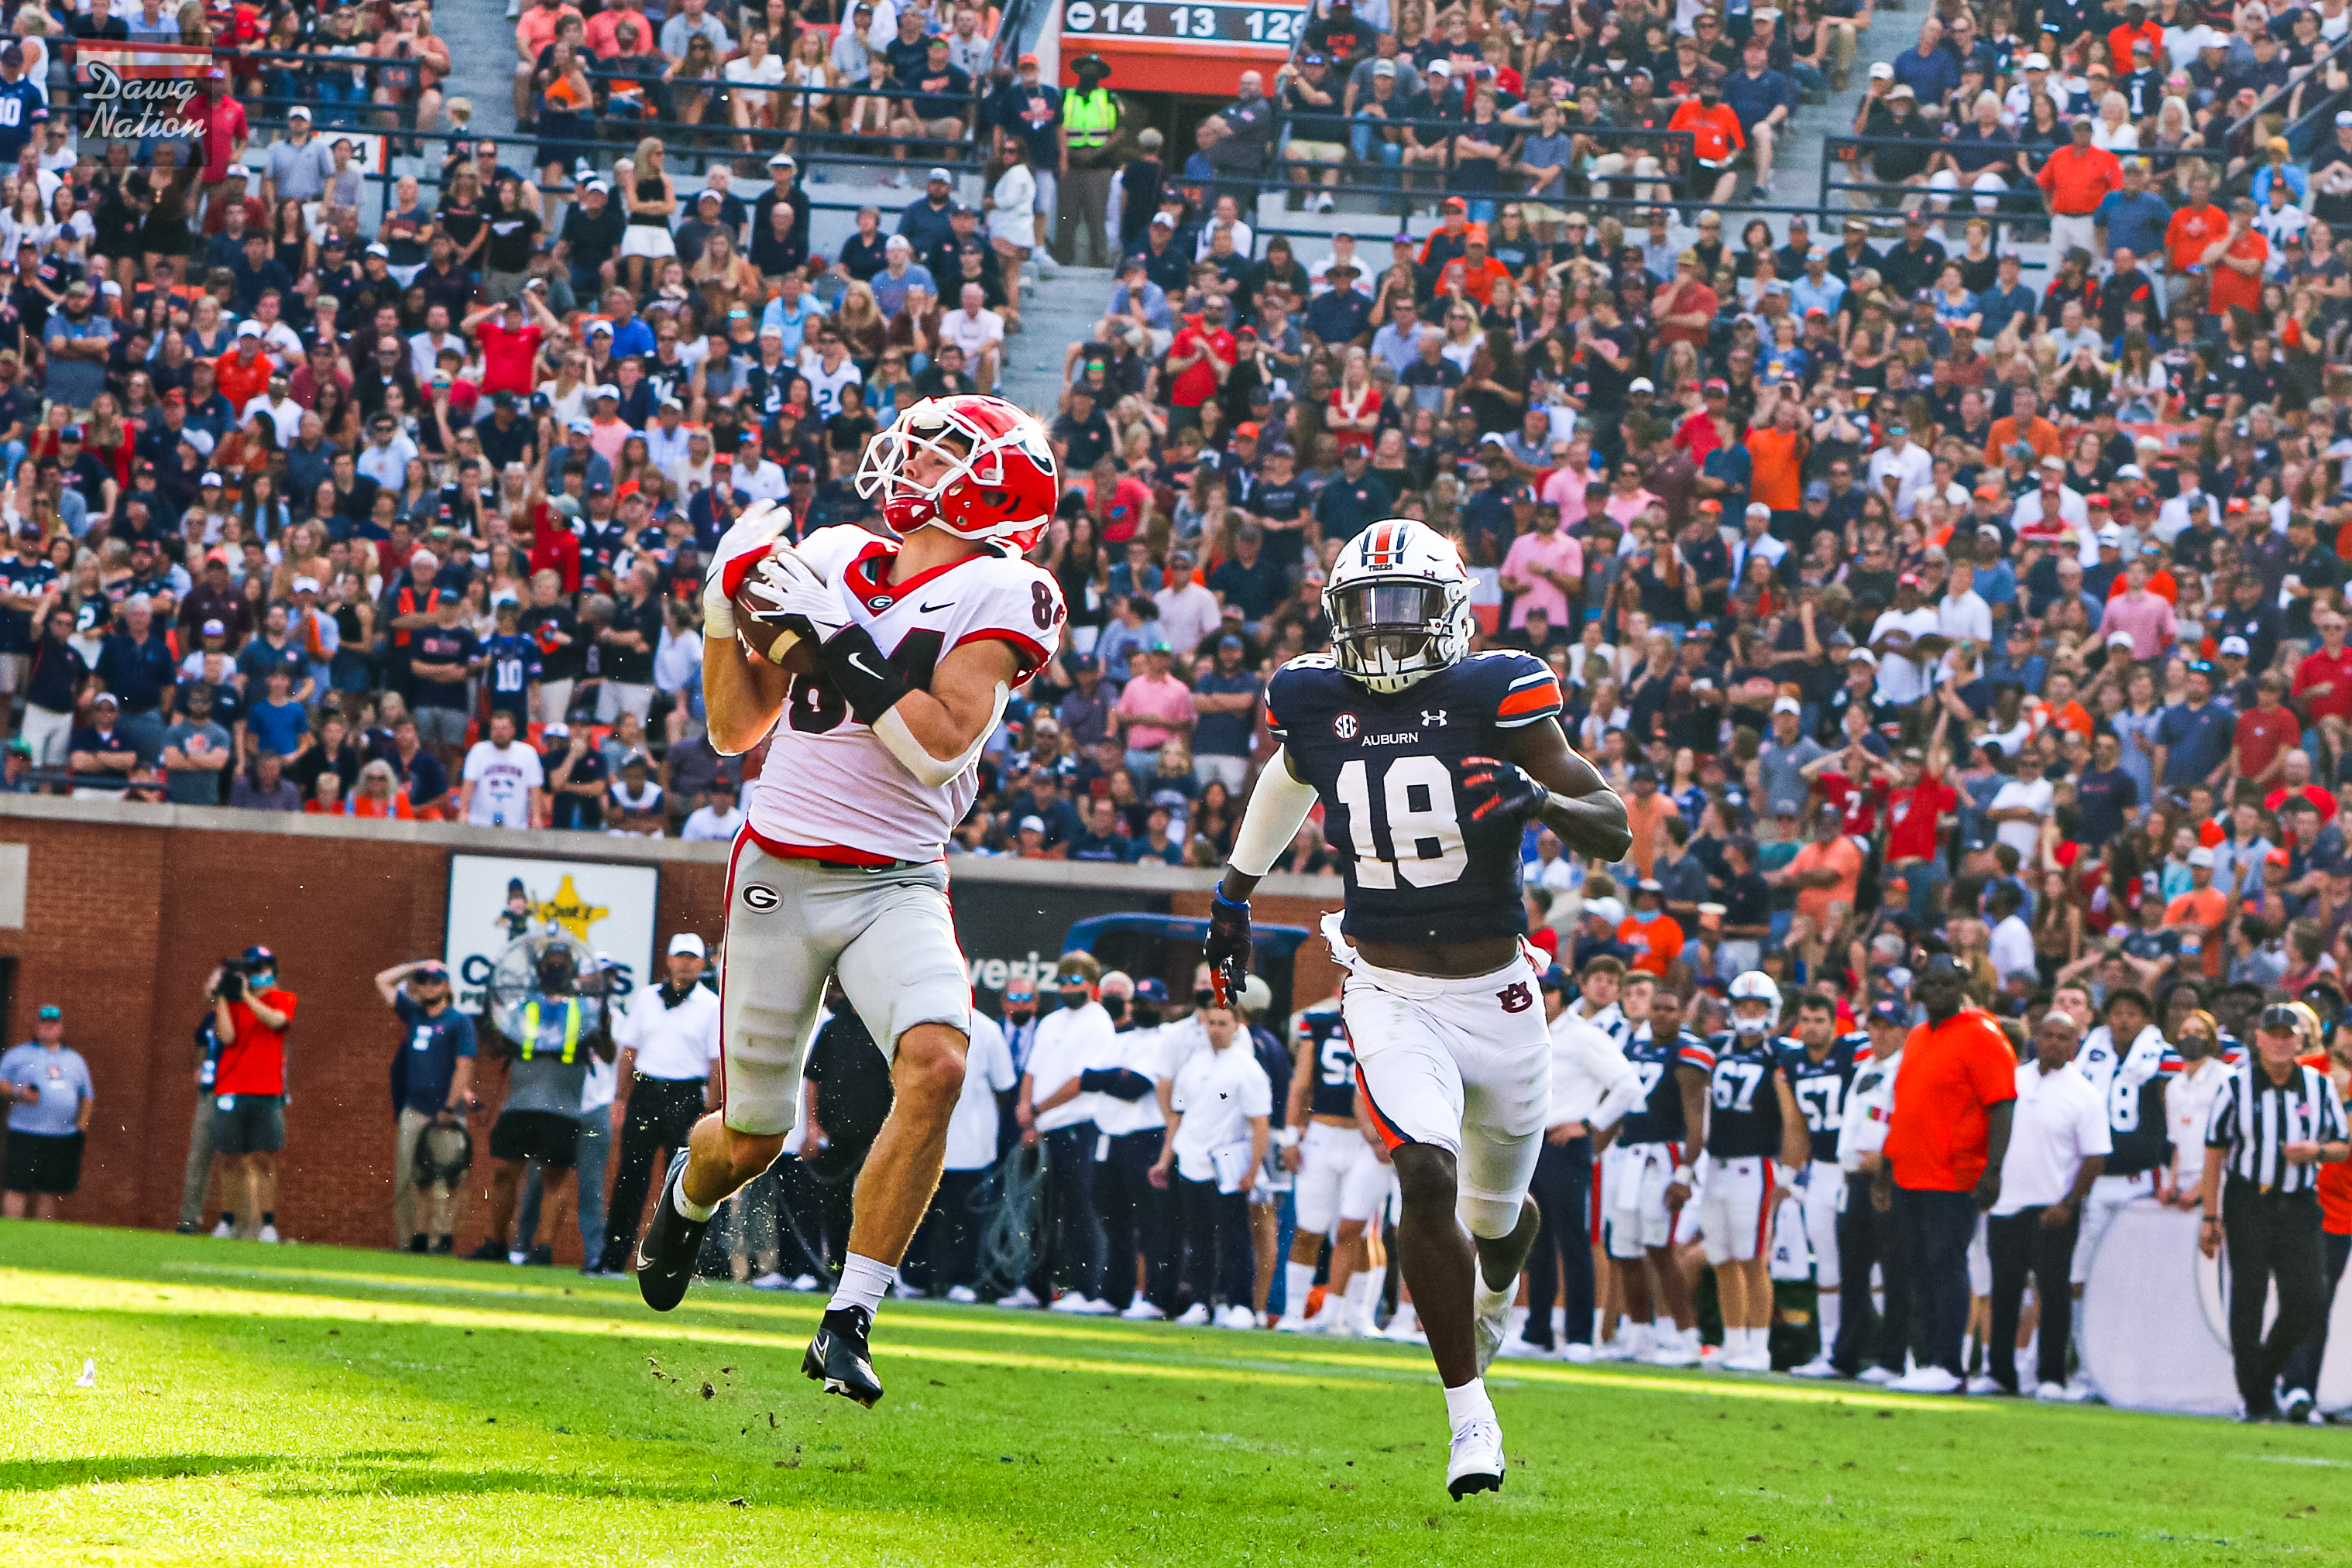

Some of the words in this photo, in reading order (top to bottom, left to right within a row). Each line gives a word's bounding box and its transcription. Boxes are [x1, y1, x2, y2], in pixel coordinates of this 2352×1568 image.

[1100, 3, 1146, 33] 14
[1170, 7, 1216, 37] 13
[0, 97, 22, 126] 0
[496, 659, 523, 691] 10
[1334, 714, 1357, 739] SEC
[1361, 732, 1419, 747] AUBURN
[1845, 791, 1861, 818] 7
[1336, 755, 1468, 889] 18
[741, 884, 779, 910] G
[967, 950, 1059, 991] veriz
[1320, 1038, 1356, 1086] 5
[1629, 1060, 1664, 1113] 7
[1712, 1059, 1764, 1112] 67
[1795, 1074, 1843, 1133] 57
